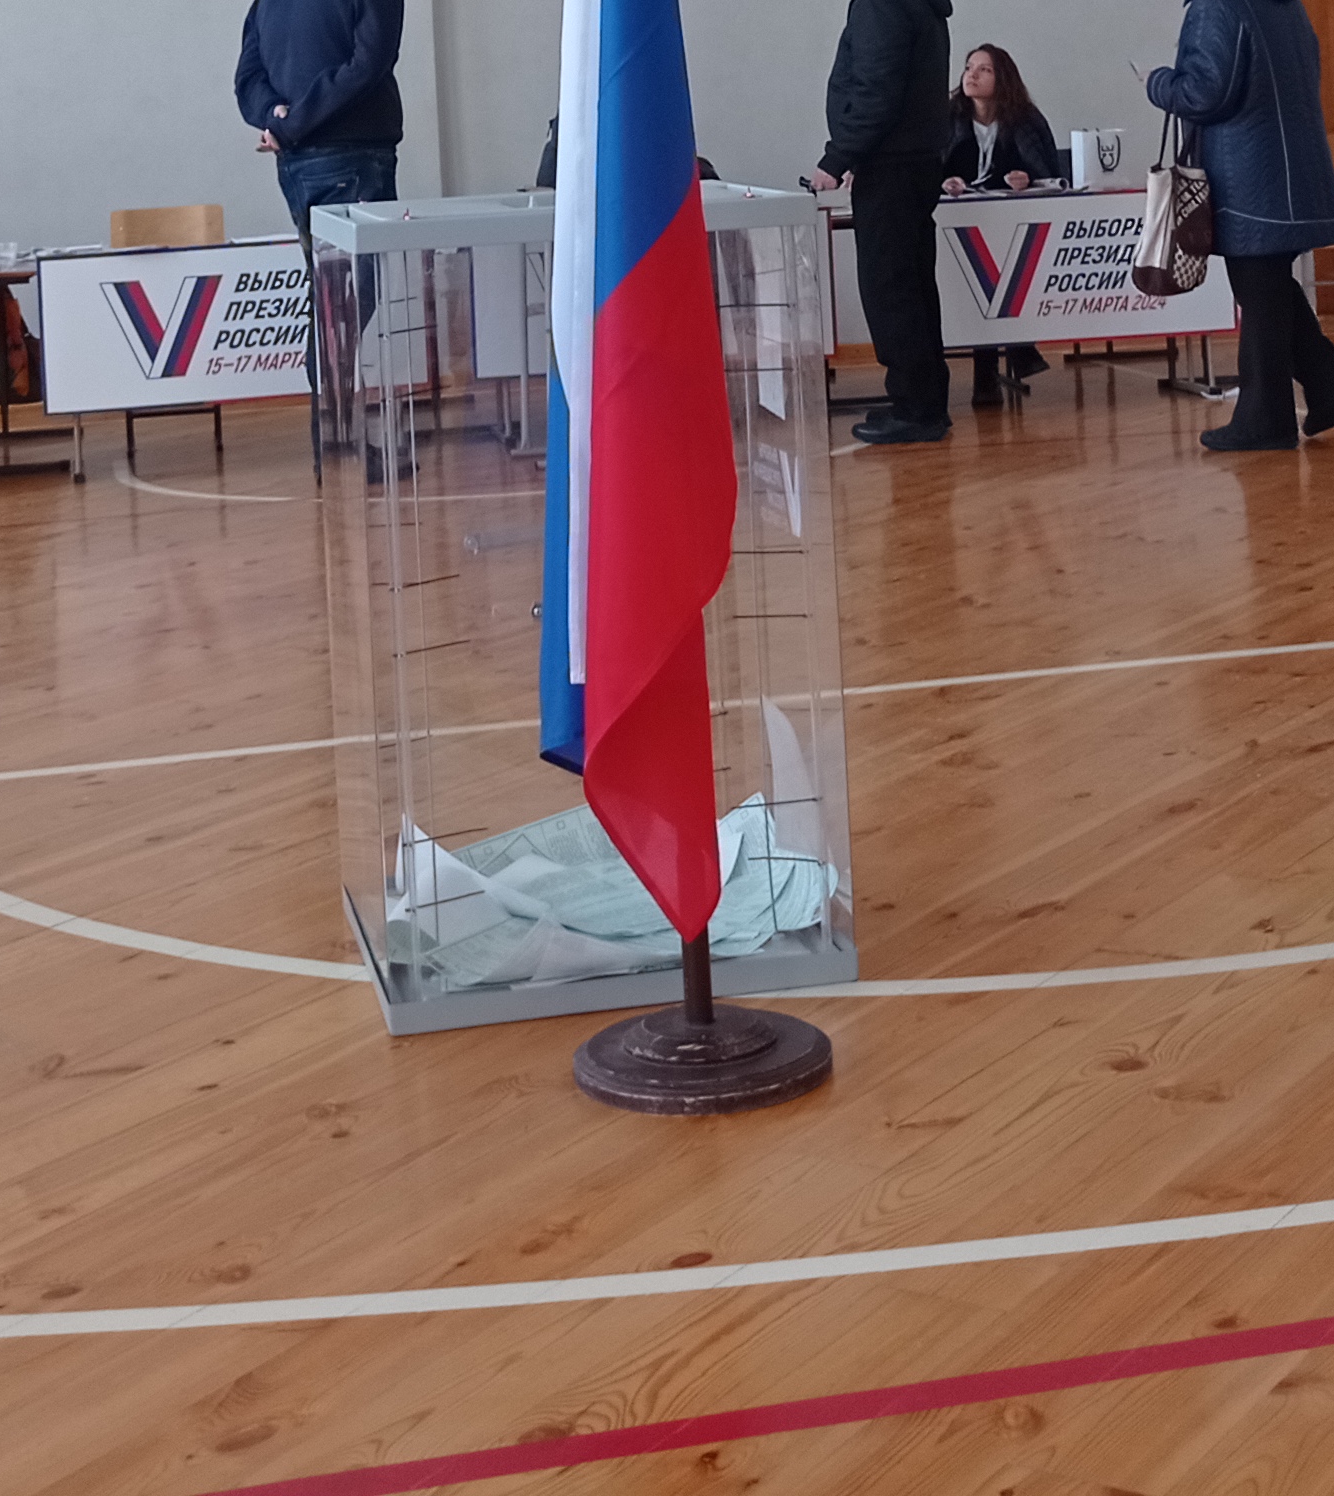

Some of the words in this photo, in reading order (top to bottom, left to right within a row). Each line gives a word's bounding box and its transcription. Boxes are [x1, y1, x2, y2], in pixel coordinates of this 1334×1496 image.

[1052, 243, 1137, 267] ПРЕЗИД
[234, 269, 311, 294] ВЫБОР
[1043, 270, 1128, 294] РОССИИ
[223, 296, 313, 322] ПРЕЗИД
[1078, 295, 1130, 315] МАРТА
[1130, 294, 1167, 312] 2024
[212, 324, 309, 352] РОССИИ
